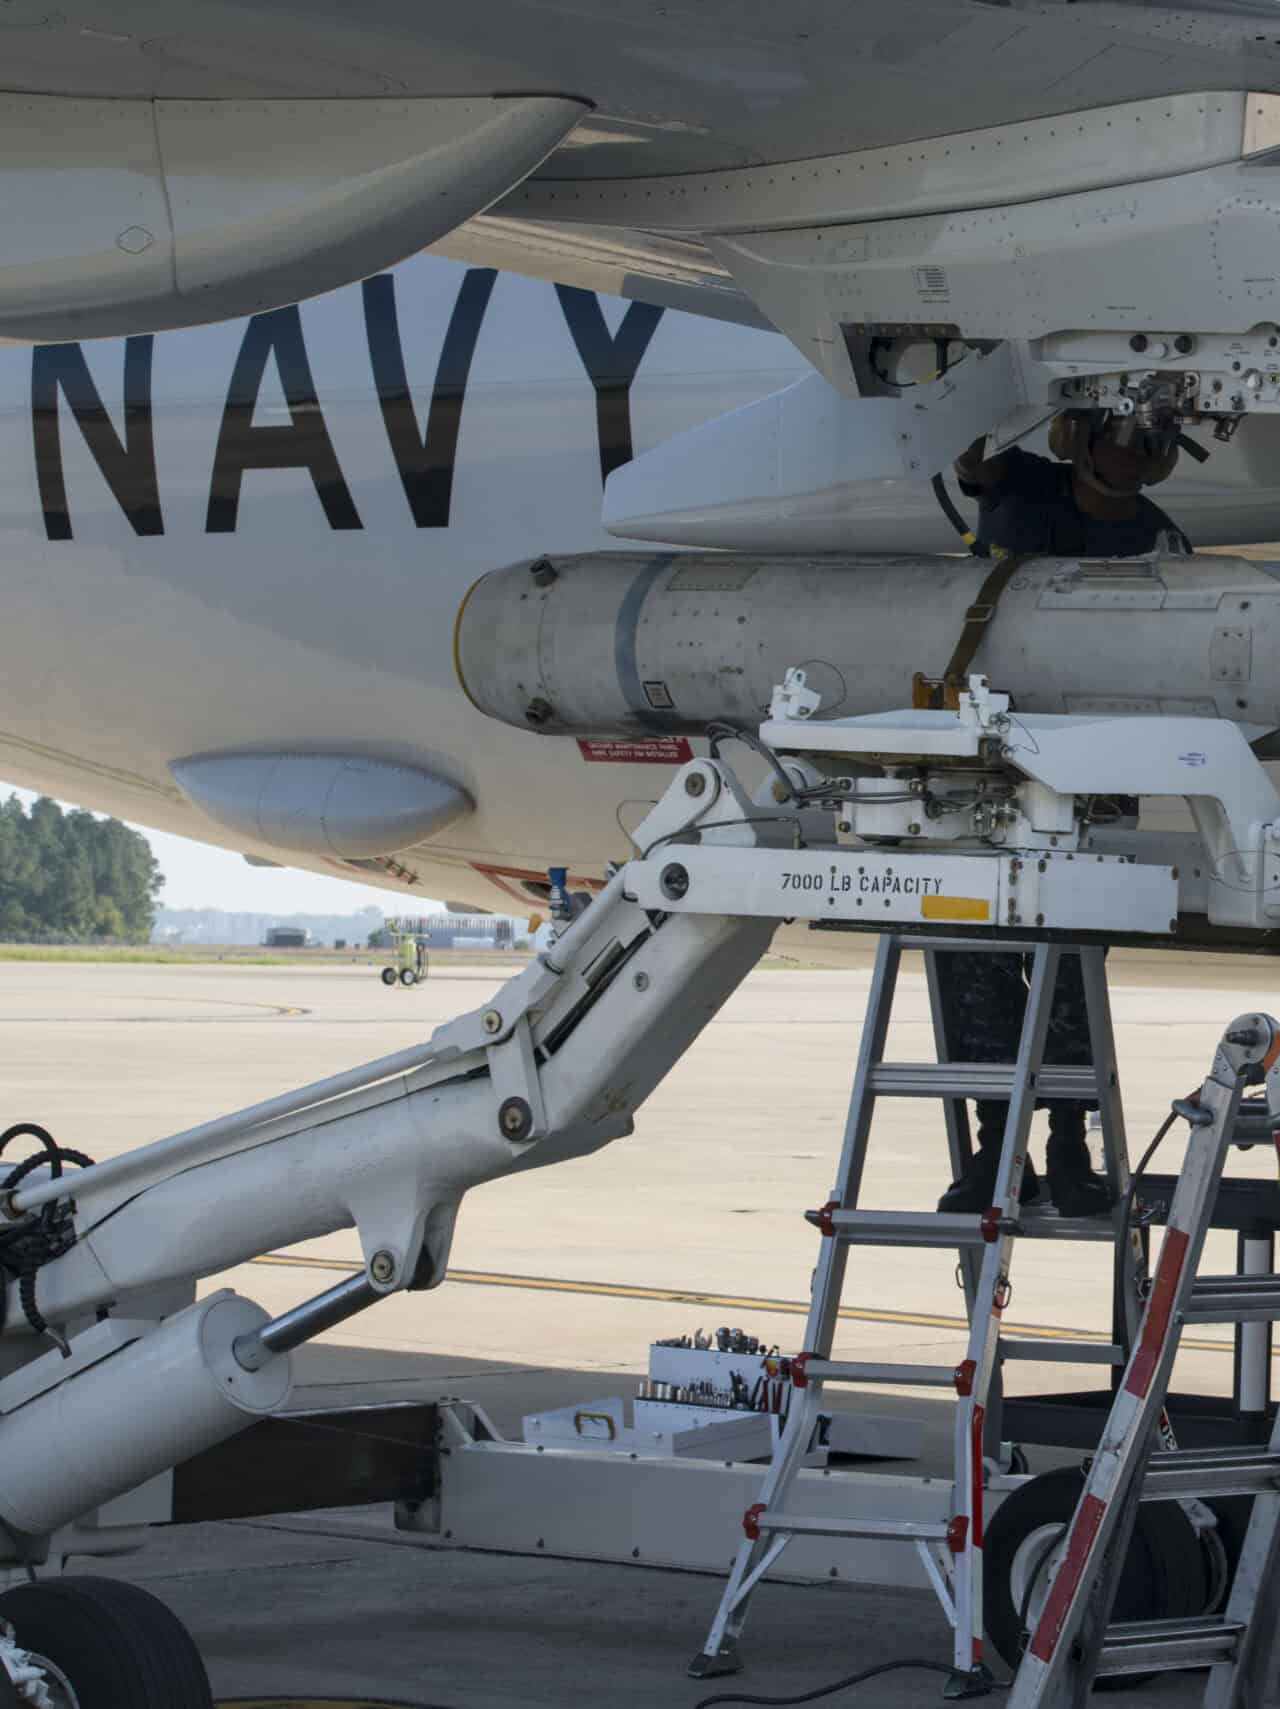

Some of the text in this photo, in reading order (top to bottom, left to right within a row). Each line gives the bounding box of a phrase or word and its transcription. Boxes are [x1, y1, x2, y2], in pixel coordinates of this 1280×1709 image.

[30, 267, 666, 541] NAVY
[781, 873, 944, 895] 7000 LB CAPACITY
